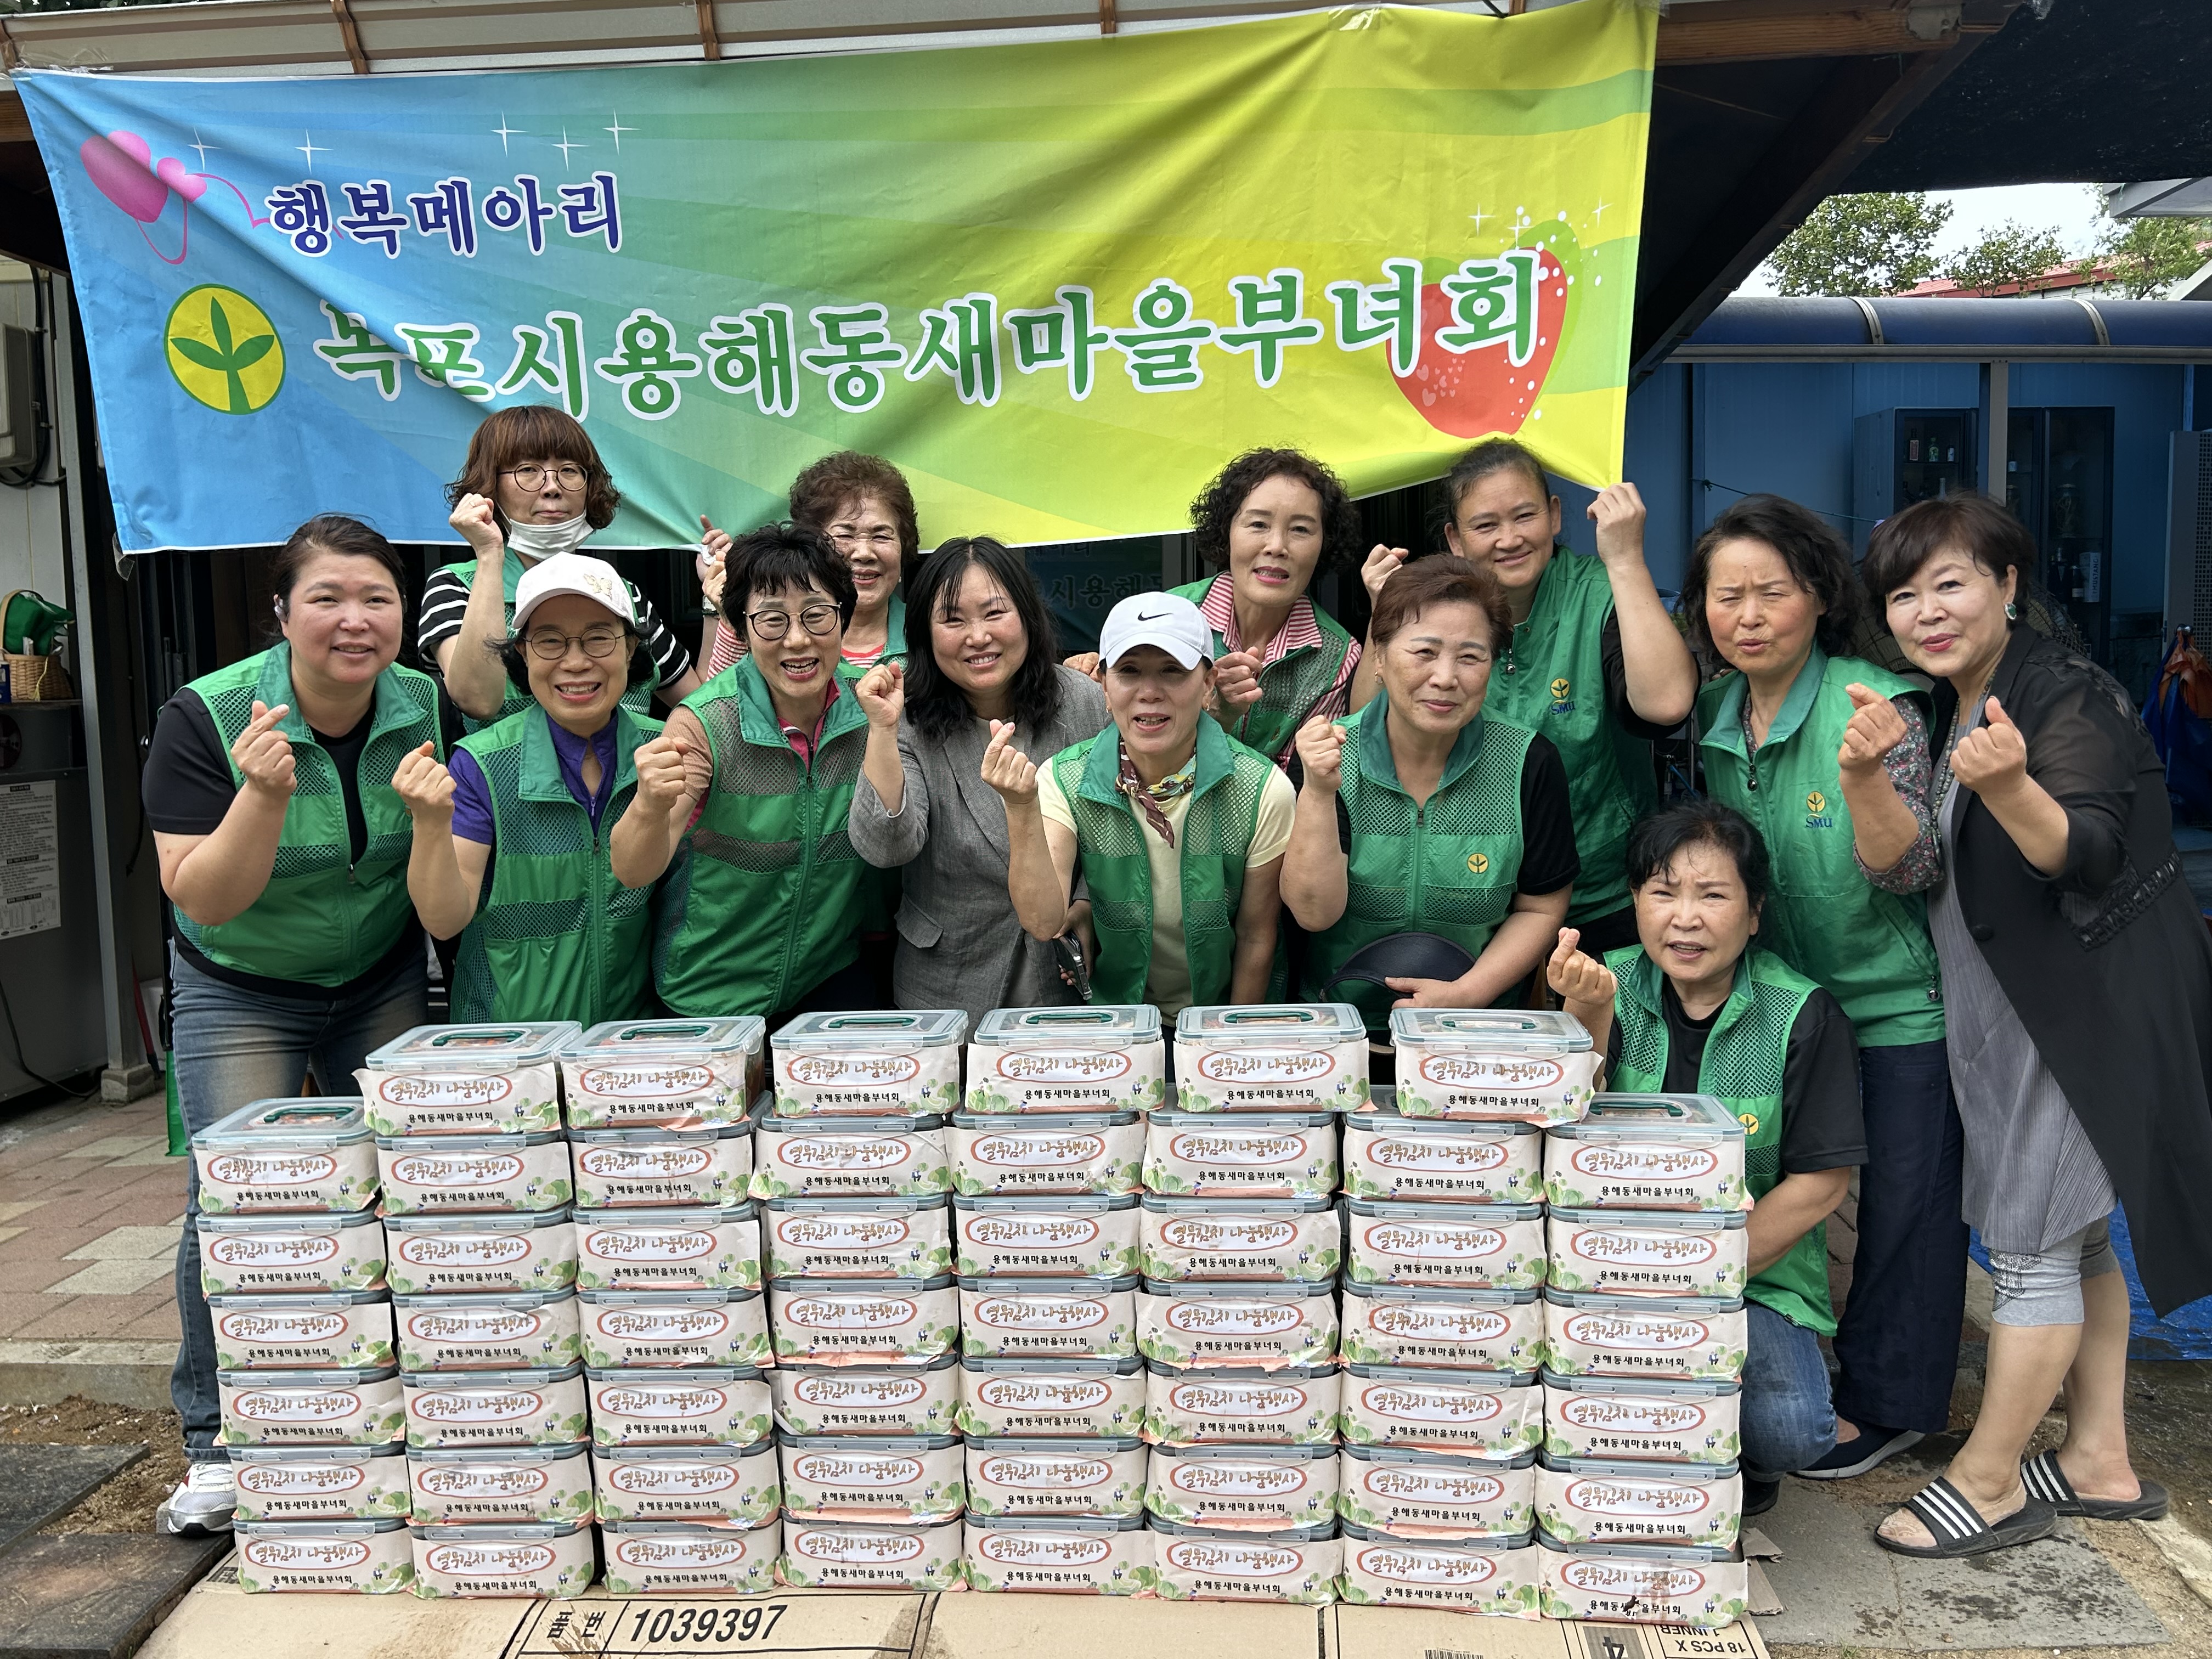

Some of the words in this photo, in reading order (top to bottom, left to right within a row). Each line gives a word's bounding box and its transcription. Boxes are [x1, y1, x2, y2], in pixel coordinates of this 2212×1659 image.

[268, 172, 622, 257] 행복메아리
[1551, 701, 1576, 715] SMU
[1805, 817, 1832, 828] SMU
[799, 1062, 849, 1080] 열무김치
[855, 1060, 912, 1078] 나눔행사
[1009, 1058, 1059, 1077] 열무김치
[1065, 1057, 1122, 1075] 나눔행사
[1210, 1058, 1262, 1077] 열무김치
[1268, 1056, 1327, 1074] 나눔행사
[1432, 1060, 1486, 1081] 열무김치
[1492, 1063, 1554, 1082] 나눔행사
[390, 1082, 441, 1101] 열무김치
[446, 1080, 504, 1098] 나눔행사
[815, 1092, 899, 1103] 용해동새마을부녀회
[1024, 1088, 1110, 1099] 용해동새마을부녀회
[1226, 1088, 1314, 1101] 용해동새마을부녀회
[1448, 1094, 1539, 1108] 용해동새마을부녀회
[407, 1111, 493, 1124] 용해동새마을부녀회
[789, 1144, 839, 1164] 열무김치
[845, 1143, 902, 1161] 나눔행사
[983, 1141, 1033, 1160] 열무김치
[1039, 1139, 1097, 1158] 나눔행사
[1182, 1138, 1233, 1158] 열무김치
[1239, 1139, 1298, 1157] 나눔행사
[1379, 1143, 1432, 1164] 열무김치
[1438, 1146, 1499, 1165] 나눔행사
[218, 1161, 268, 1180] 열무김치
[273, 1159, 328, 1176] 나눔행사
[1584, 1152, 1639, 1172] 열무김치
[1646, 1153, 1708, 1172] 나눔행사
[403, 1162, 453, 1181] 열무김치
[458, 1160, 515, 1177] 나눔행사
[998, 1171, 1085, 1183] 용해동새마을부녀회
[1198, 1171, 1285, 1181] 용해동새마을부녀회
[805, 1176, 890, 1187] 용해동새마을부녀회
[1395, 1176, 1485, 1190] 용해동새마을부녀회
[235, 1190, 319, 1201] 용해동새마을부녀회
[419, 1191, 505, 1203] 용해동새마을부녀회
[1601, 1185, 1694, 1198] 용해동새마을부녀회
[789, 1223, 838, 1243] 열무김치
[844, 1223, 901, 1241] 나눔행사
[977, 1222, 1027, 1242] 열무김치
[1033, 1222, 1090, 1240] 나눔행사
[1172, 1224, 1224, 1244] 열무김치
[1230, 1224, 1289, 1243] 나눔행사
[1377, 1229, 1430, 1250] 열무김치
[1436, 1232, 1497, 1250] 나눔행사
[221, 1243, 269, 1261] 열무김치
[275, 1241, 330, 1258] 나눔행사
[410, 1243, 460, 1261] 열무김치
[466, 1240, 523, 1258] 나눔행사
[1584, 1235, 1638, 1256] 열무김치
[1645, 1239, 1707, 1259] 나눔행사
[804, 1255, 889, 1265] 용해동새마을부녀회
[992, 1254, 1077, 1265] 용해동새마을부녀회
[1188, 1257, 1276, 1268] 용해동새마을부녀회
[238, 1272, 321, 1283] 용해동새마을부녀회
[427, 1272, 512, 1283] 용해동새마을부녀회
[1393, 1263, 1483, 1276] 용해동새마을부녀회
[1599, 1269, 1692, 1285] 용해동새마을부녀회
[797, 1304, 846, 1323] 열무김치
[852, 1303, 909, 1321] 나눔행사
[986, 1304, 1036, 1323] 열무김치
[1042, 1304, 1099, 1323] 나눔행사
[1178, 1308, 1229, 1328] 열무김치
[1235, 1308, 1295, 1327] 나눔행사
[230, 1318, 279, 1336] 열무김치
[284, 1317, 340, 1334] 나눔행사
[608, 1315, 658, 1334] 열무김치
[663, 1314, 720, 1332] 나눔행사
[1381, 1311, 1435, 1331] 열무김치
[1441, 1314, 1502, 1334] 나눔행사
[1576, 1321, 1630, 1341] 열무김치
[1637, 1323, 1700, 1342] 나눔행사
[812, 1335, 896, 1345] 용해동새마을부녀회
[1002, 1336, 1087, 1347] 용해동새마을부녀회
[1194, 1340, 1282, 1351] 용해동새마을부녀회
[247, 1348, 330, 1358] 용해동새마을부녀회
[624, 1346, 708, 1357] 용해동새마을부녀회
[1397, 1344, 1487, 1359] 용해동새마을부녀회
[1592, 1354, 1685, 1368] 용해동새마을부녀회
[806, 1382, 855, 1401] 열무김치
[861, 1381, 918, 1400] 나눔행사
[990, 1385, 1040, 1404] 열무김치
[1046, 1385, 1103, 1403] 나눔행사
[1182, 1389, 1233, 1409] 열무김치
[1239, 1390, 1298, 1409] 나눔행사
[422, 1398, 472, 1417] 열무김치
[477, 1396, 533, 1413] 나눔행사
[608, 1392, 657, 1412] 열무김치
[663, 1392, 718, 1410] 나눔행사
[1374, 1391, 1426, 1412] 열무김치
[1432, 1396, 1493, 1415] 나눔행사
[821, 1414, 906, 1424] 용해동새마을부녀회
[1005, 1416, 1091, 1427] 용해동새마을부녀회
[1573, 1403, 1628, 1423] 열무김치
[1634, 1407, 1696, 1425] 나눔행사
[439, 1426, 523, 1438] 용해동새마을부녀회
[624, 1424, 707, 1434] 용해동새마을부녀회
[1198, 1421, 1285, 1434] 용해동새마을부녀회
[1389, 1424, 1479, 1441] 용해동새마을부녀회
[1589, 1436, 1681, 1451] 용해동새마을부녀회
[805, 1460, 854, 1479] 열무김치
[859, 1462, 915, 1479] 나눔행사
[991, 1463, 1041, 1482] 열무김치
[1047, 1463, 1104, 1481] 나눔행사
[247, 1471, 296, 1489] 열무김치
[301, 1470, 356, 1487] 나눔행사
[620, 1471, 669, 1489] 열무김치
[675, 1470, 730, 1487] 나눔행사
[1182, 1469, 1233, 1488] 열무김치
[1239, 1470, 1298, 1488] 나눔행사
[1376, 1473, 1429, 1493] 열무김치
[1435, 1478, 1495, 1497] 나눔행사
[264, 1499, 347, 1510] 용해동새마을부녀회
[820, 1491, 903, 1503] 용해동새마을부녀회
[1007, 1494, 1092, 1505] 용해동새마을부녀회
[1578, 1486, 1632, 1507] 열무김치
[1638, 1489, 1700, 1509] 나눔행사
[636, 1500, 720, 1511] 용해동새마을부녀회
[1198, 1501, 1285, 1513] 용해동새마을부녀회
[1391, 1506, 1481, 1522] 용해동새마을부녀회
[1594, 1521, 1686, 1535] 용해동새마을부녀회
[255, 1545, 302, 1563] 열무김치
[308, 1545, 362, 1562] 나눔행사
[806, 1536, 854, 1555] 열무김치
[860, 1538, 916, 1556] 나눔행사
[990, 1539, 1040, 1558] 열무김치
[1046, 1541, 1103, 1559] 나눔행사
[1178, 1547, 1229, 1567] 열무김치
[1235, 1551, 1294, 1569] 나눔행사
[1369, 1554, 1421, 1573] 열무김치
[1427, 1559, 1487, 1577] 나눔행사
[272, 1575, 352, 1584] 용해동새마을부녀회
[821, 1567, 904, 1580] 용해동새마을부녀회
[1006, 1571, 1091, 1583] 용해동새마을부녀회
[1194, 1579, 1280, 1594] 용해동새마을부녀회
[1384, 1586, 1473, 1602] 용해동새마을부녀회
[630, 1604, 788, 1643] 1039397
[1602, 1636, 1626, 1659] 4
[1674, 1639, 1685, 1652] X
[1690, 1640, 1725, 1653] PCS
[1728, 1641, 1746, 1654] 18
